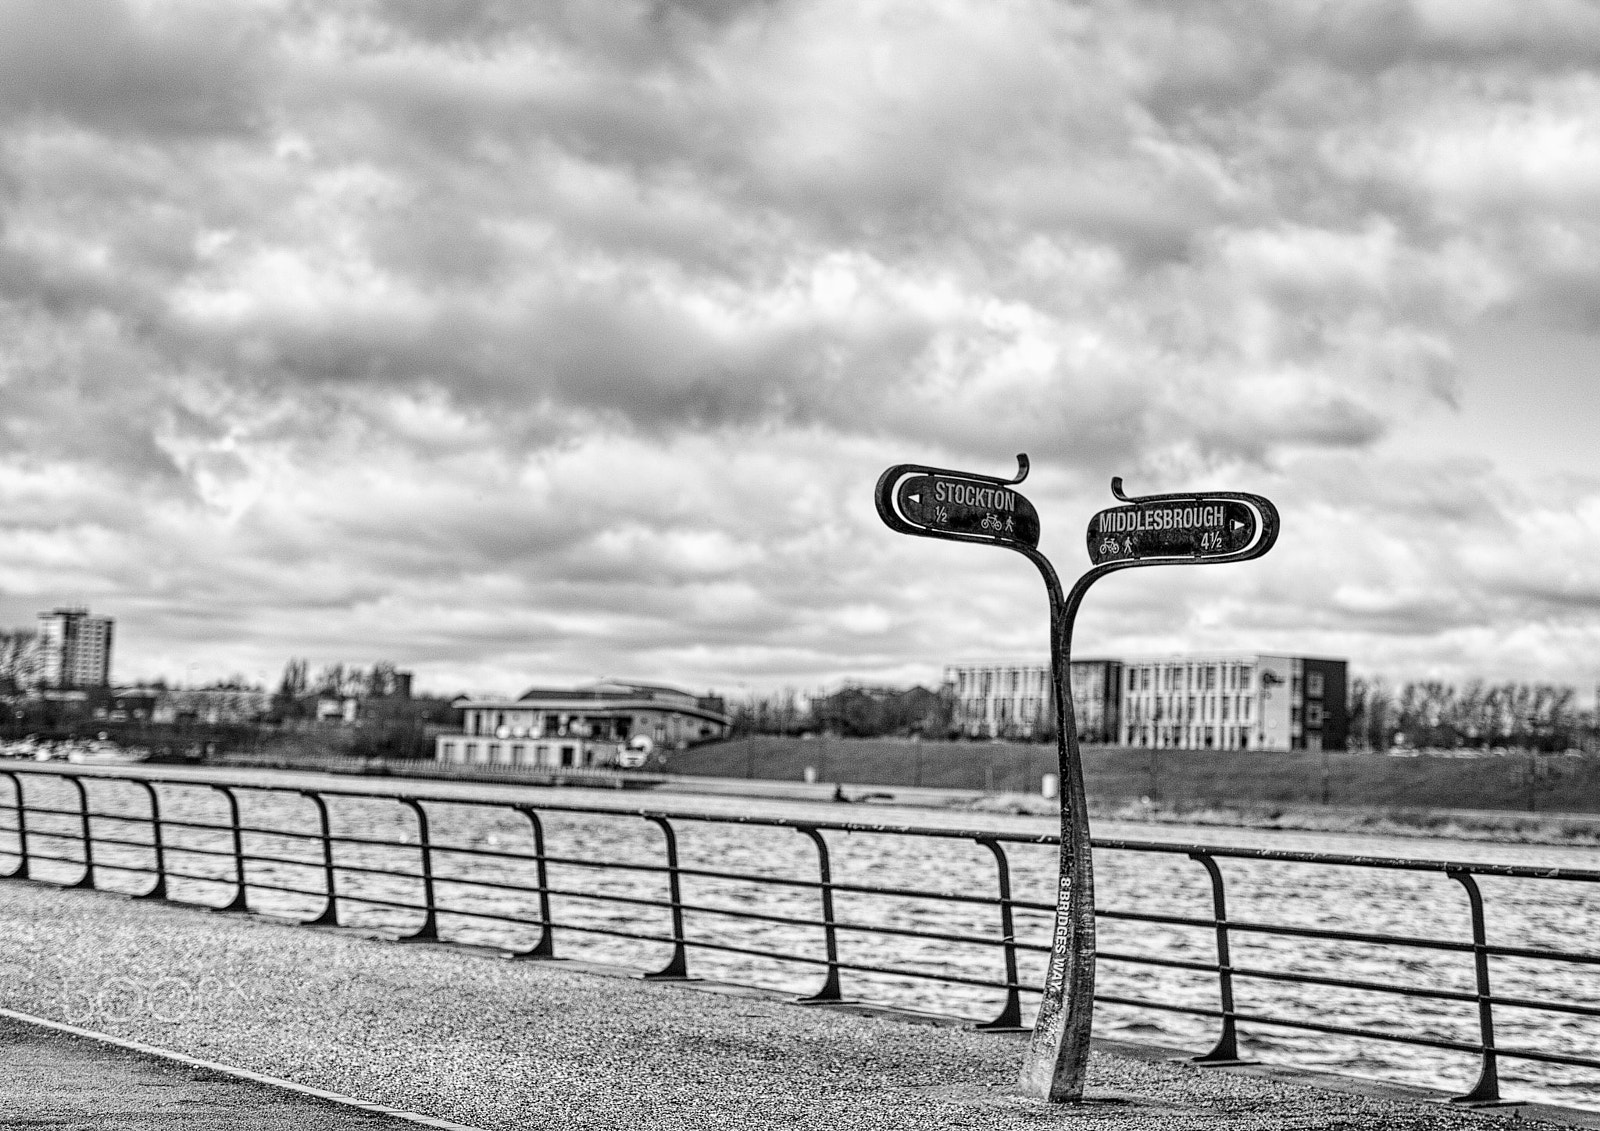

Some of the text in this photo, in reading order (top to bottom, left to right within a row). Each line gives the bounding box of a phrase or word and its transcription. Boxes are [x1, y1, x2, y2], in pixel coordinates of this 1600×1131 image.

[935, 481, 1015, 512] STOCKTON
[1099, 505, 1224, 533] MIDDLESBROUGH
[1050, 876, 1071, 992] 8 BRIDGES WAY
